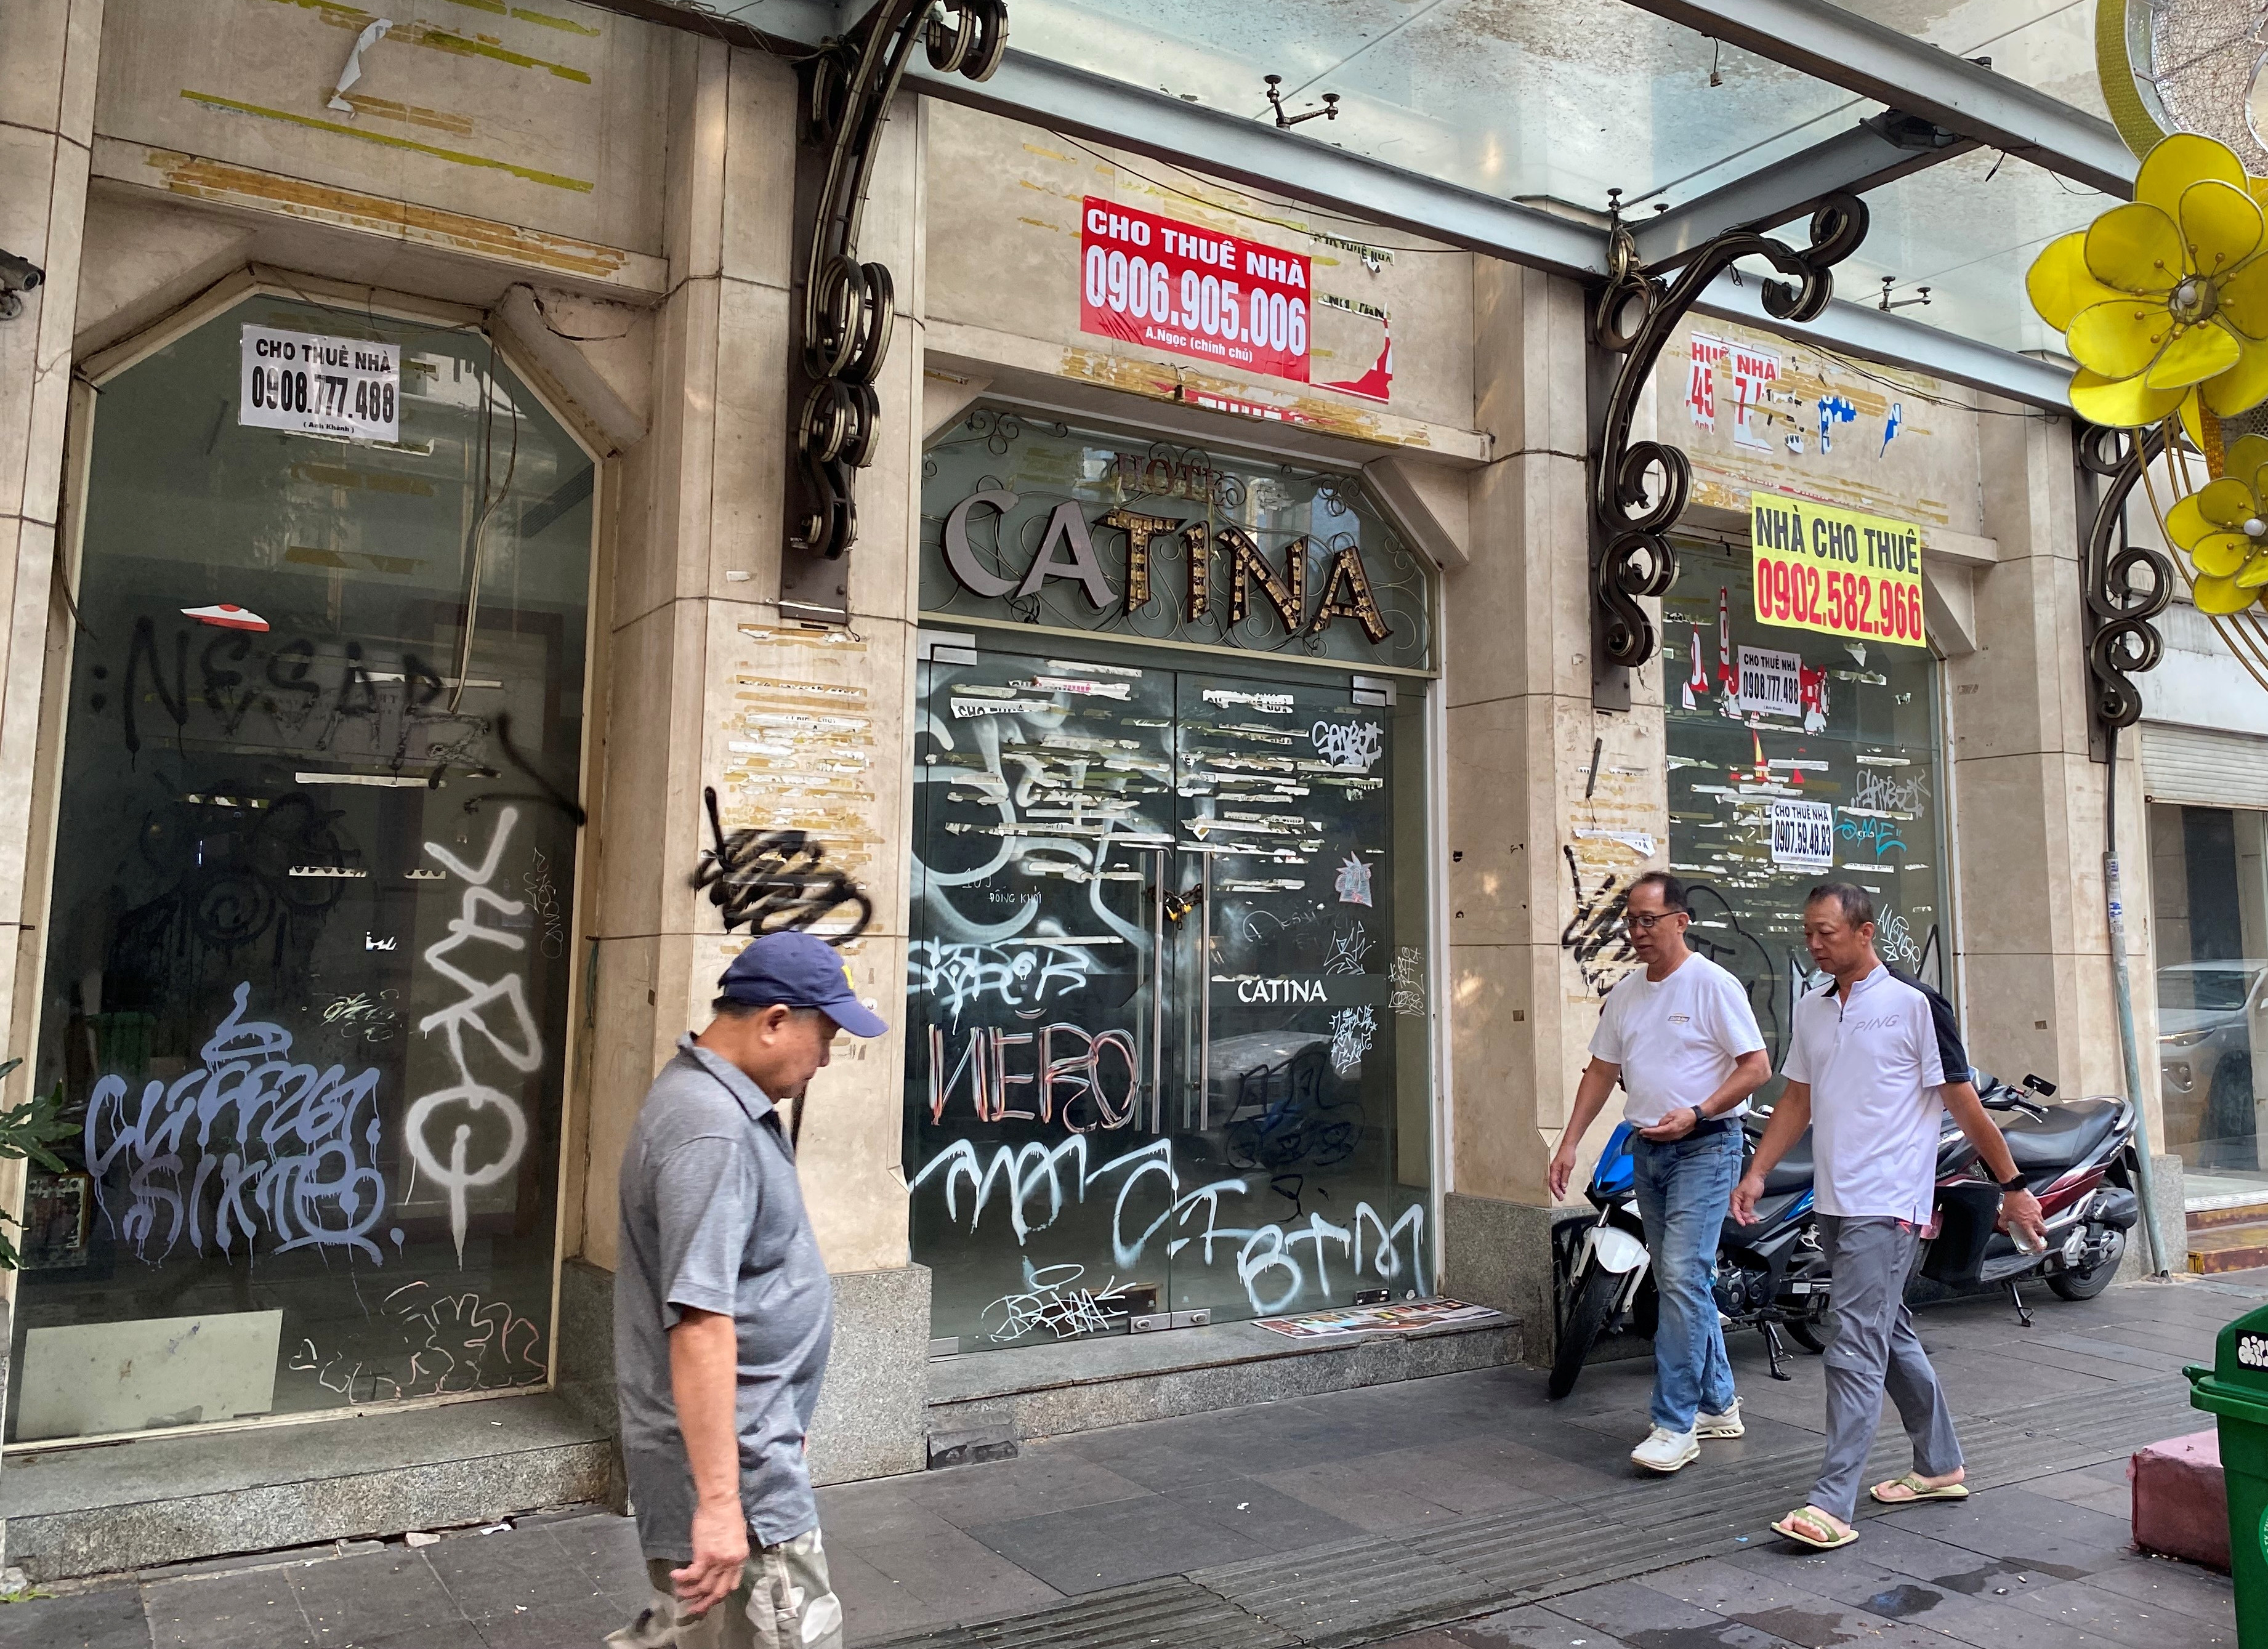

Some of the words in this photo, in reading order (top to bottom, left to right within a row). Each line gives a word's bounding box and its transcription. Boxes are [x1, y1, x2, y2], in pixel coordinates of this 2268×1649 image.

[1087, 209, 1150, 246] CHO
[1161, 228, 1237, 270] THUÊ
[1246, 257, 1306, 289] NHÀ
[1085, 244, 1306, 357] 0906.905.006
[256, 339, 295, 360] CHO
[302, 345, 349, 368] THUÊ
[355, 350, 391, 373] NHÀ
[1145, 326, 1187, 349] A.Ngọc
[1190, 336, 1225, 356] (chính
[1228, 345, 1253, 363] chủ)
[1737, 354, 1776, 381] NHÀ
[252, 366, 393, 423] 0908.777.488
[1757, 505, 1806, 554] NHÀ
[1813, 518, 1858, 563] CHO
[1864, 529, 1919, 575] THUÊ
[941, 490, 1395, 645] CATINA
[1758, 558, 1922, 641] 0902.582.966
[1744, 654, 1759, 666] CHO
[1761, 655, 1780, 669] THUÊ
[1781, 658, 1796, 672] NHÀ
[1743, 671, 1798, 704] 0908.777.488
[1775, 805, 1790, 818] CHO
[1792, 805, 1811, 820] THUÊ
[1813, 806, 1828, 821] NHÀ
[1775, 820, 1831, 856] 0907.59.48.83
[1238, 979, 1328, 1002] CATINA
[1851, 1015, 1899, 1034] PING
